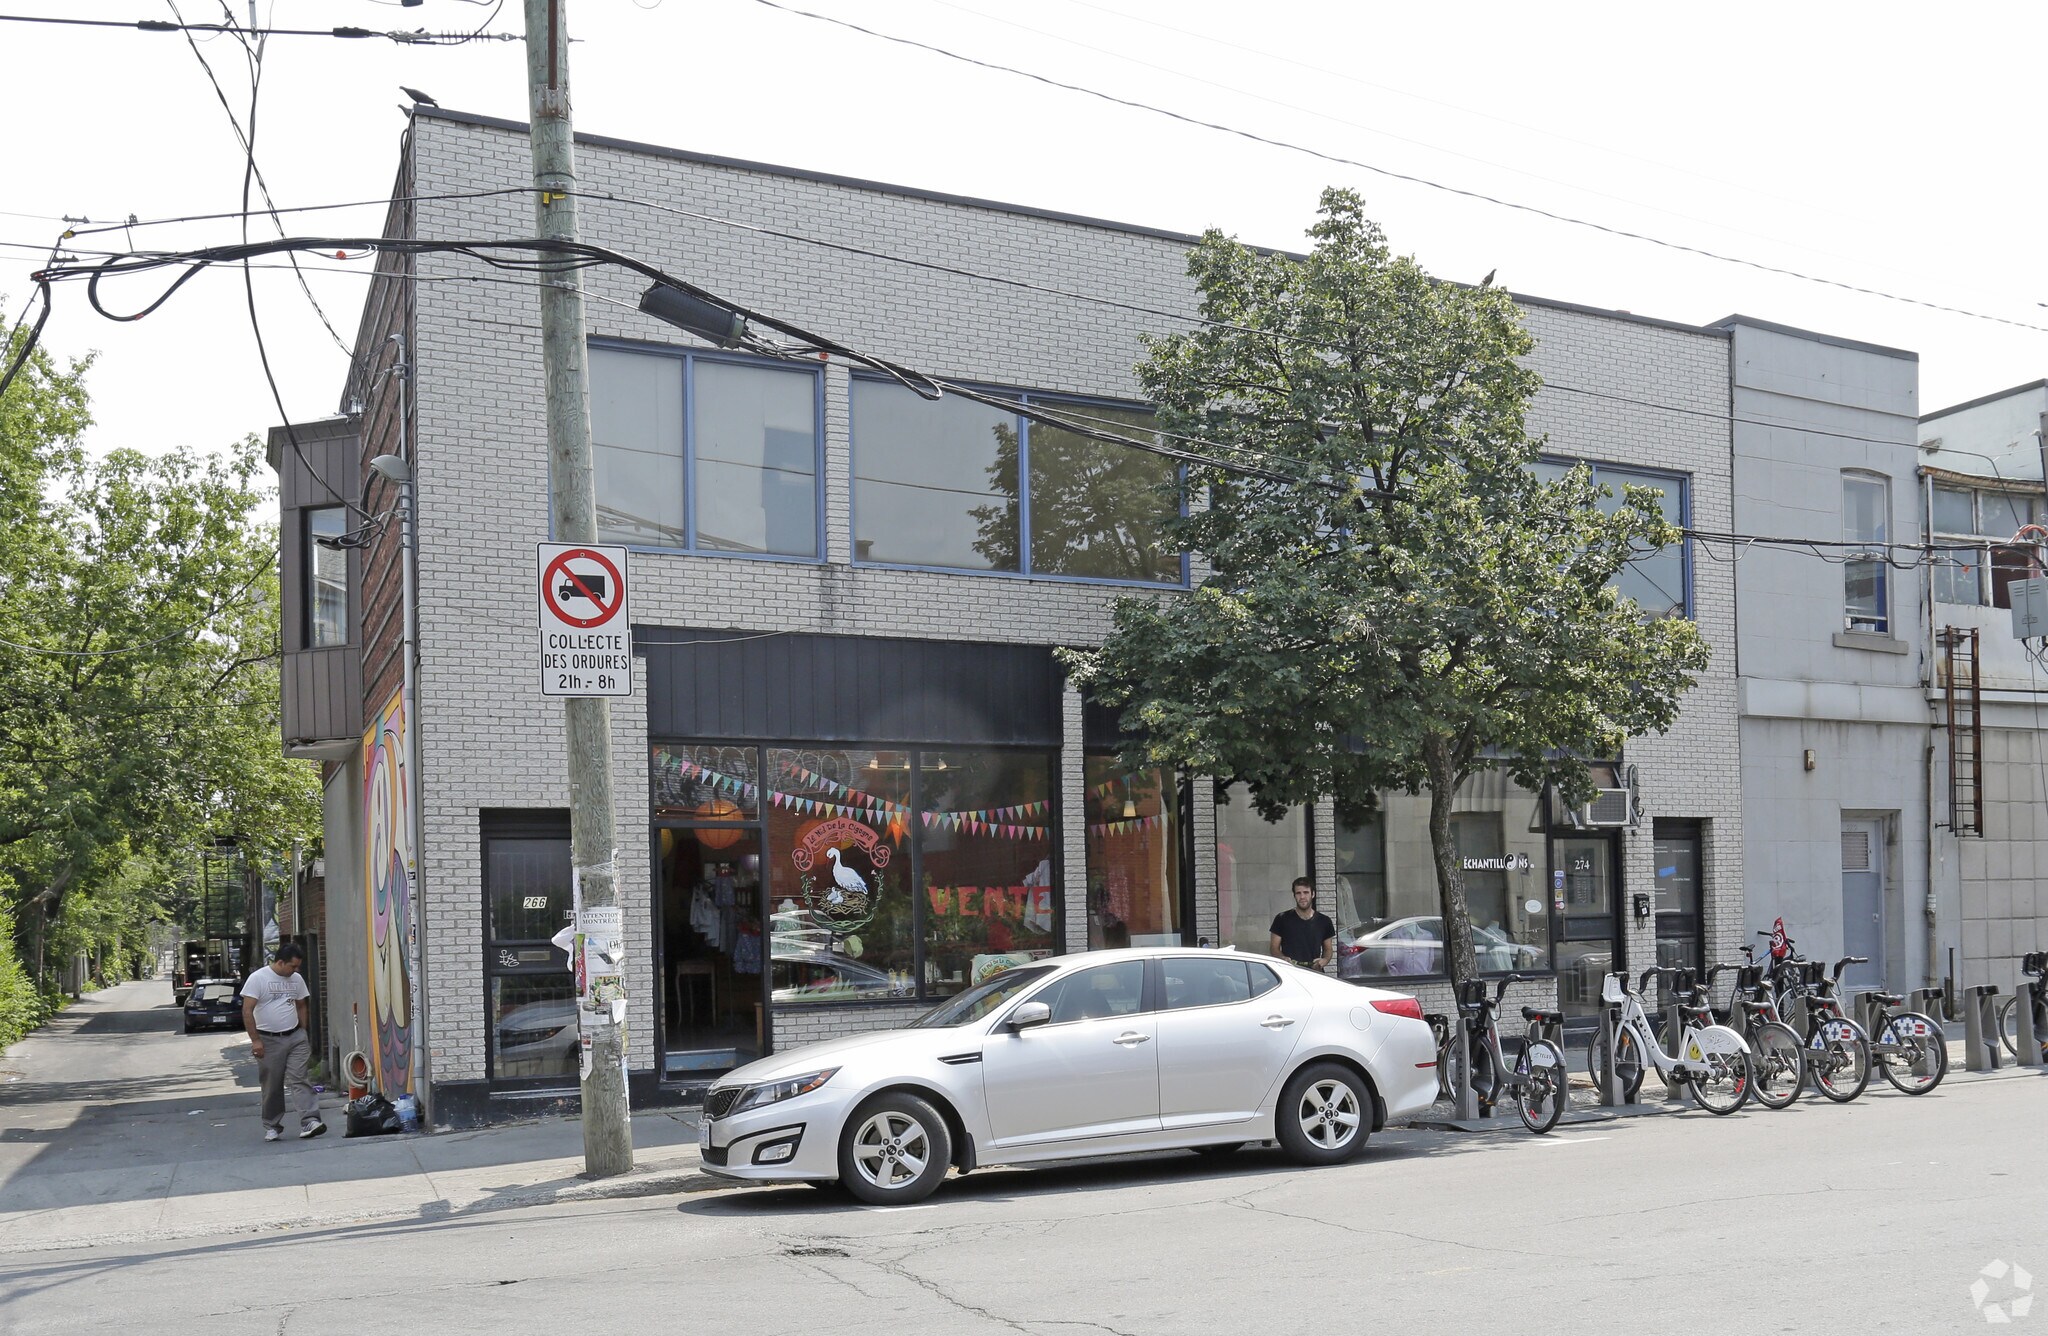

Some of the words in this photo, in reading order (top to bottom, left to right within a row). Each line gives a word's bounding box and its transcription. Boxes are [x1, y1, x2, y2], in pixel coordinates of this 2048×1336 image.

[549, 634, 622, 650] COLLECTE
[545, 654, 567, 669] DES
[572, 654, 628, 670] ORDURES
[558, 674, 581, 689] 21h
[598, 675, 616, 689] 8h
[827, 822, 836, 830] De
[838, 820, 846, 830] La
[848, 823, 874, 841] Cigogne
[1574, 860, 1590, 870] 274
[524, 897, 546, 908] 266
[928, 886, 1055, 919] VENTE
